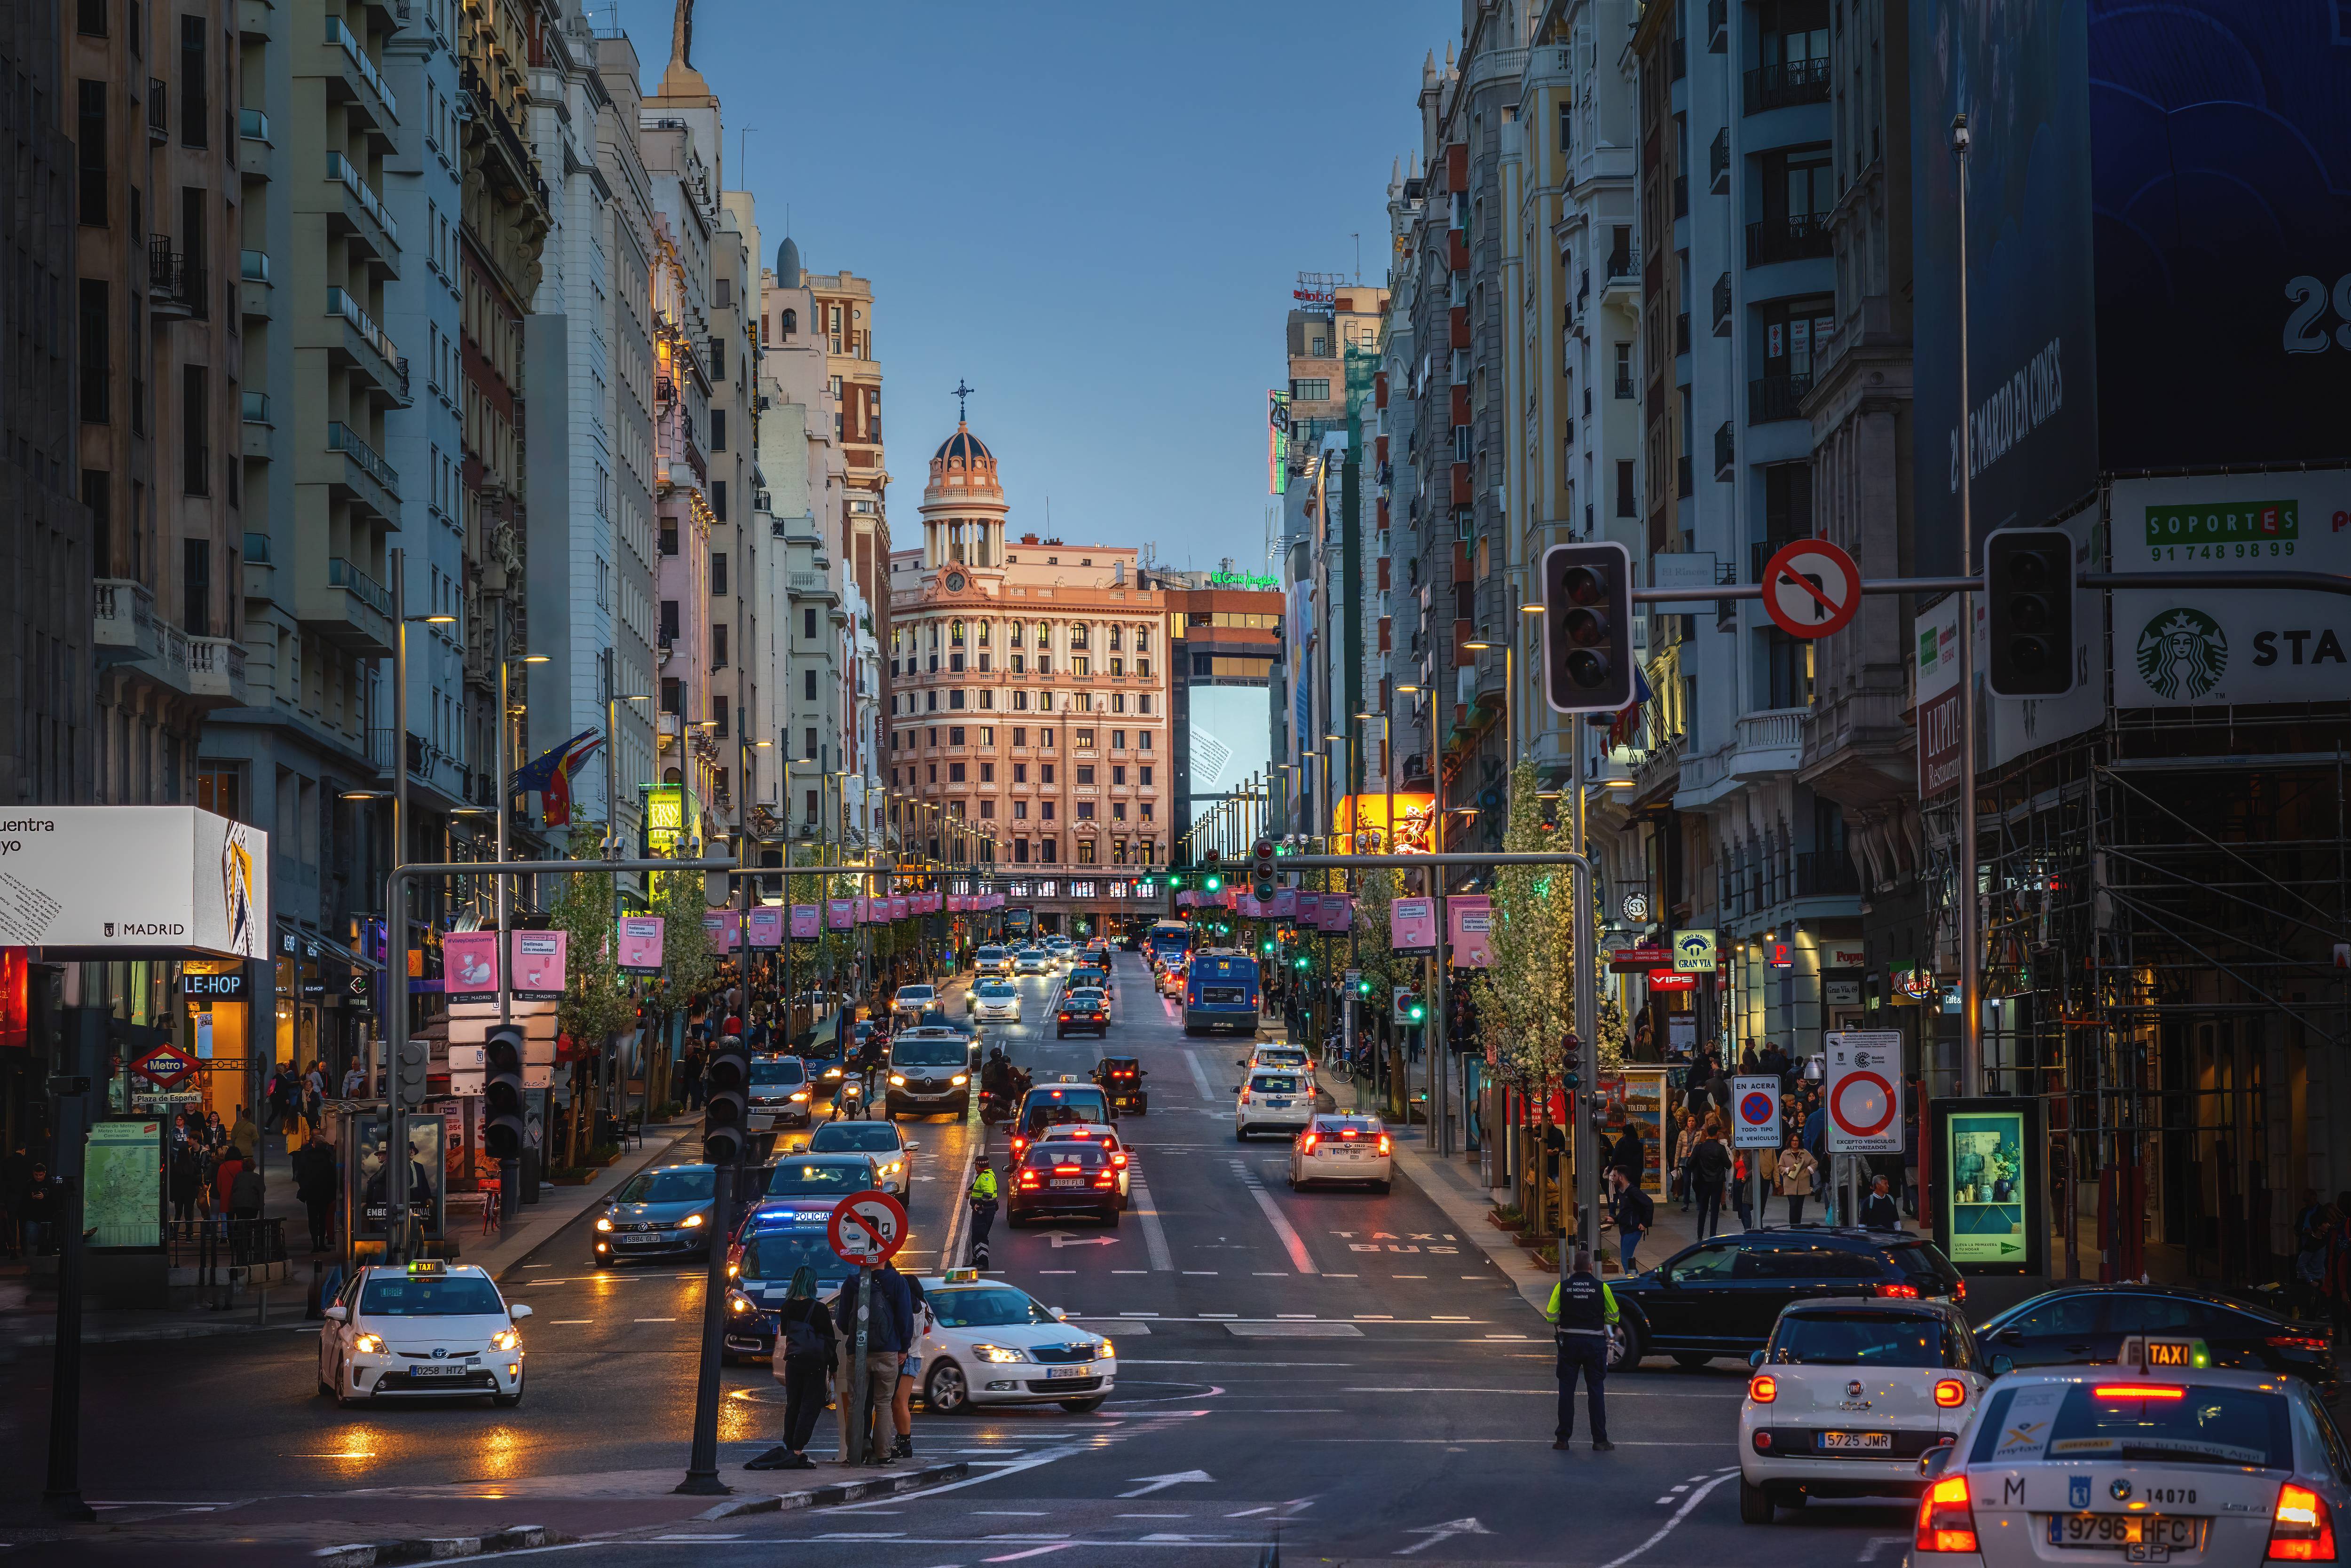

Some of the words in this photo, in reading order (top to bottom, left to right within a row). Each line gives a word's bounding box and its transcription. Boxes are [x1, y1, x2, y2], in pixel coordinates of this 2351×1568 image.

[1978, 382, 2012, 470] MARZO
[2015, 367, 2029, 443] EN
[2030, 337, 2063, 428] CINES
[2151, 510, 2294, 535] SOPORTES
[2152, 547, 2175, 562] 91
[2186, 545, 2225, 560] 748
[2235, 544, 2260, 558] 98
[2270, 542, 2295, 557] 99
[1211, 571, 1222, 583] El
[651, 804, 679, 816] FRAN
[124, 924, 184, 935] MADRID
[1678, 935, 1694, 949] CENTRO
[1695, 934, 1712, 948] MEDICO
[1775, 945, 1787, 960] P
[1836, 951, 1863, 964] Popu
[1679, 959, 1697, 968] GRAN
[150, 1061, 181, 1070] Metro
[170, 1094, 197, 1103] España
[1330, 1231, 1458, 1241] TAXI
[1349, 1244, 1459, 1254] BUS
[380, 1287, 403, 1297] LIBRE
[2150, 1345, 2189, 1364] TAXI
[446, 1366, 464, 1375] HTZ
[1828, 1435, 1860, 1446] 5725
[1864, 1435, 1888, 1447] JMR
[2174, 1442, 2199, 1451] taxi
[1997, 1444, 2043, 1456] mytaxi
[2004, 1477, 2025, 1505] M
[2146, 1489, 2196, 1504] 14070
[2069, 1519, 2127, 1541] 9796
[2141, 1520, 2185, 1542] HFC
[2132, 1545, 2164, 1560] SP
